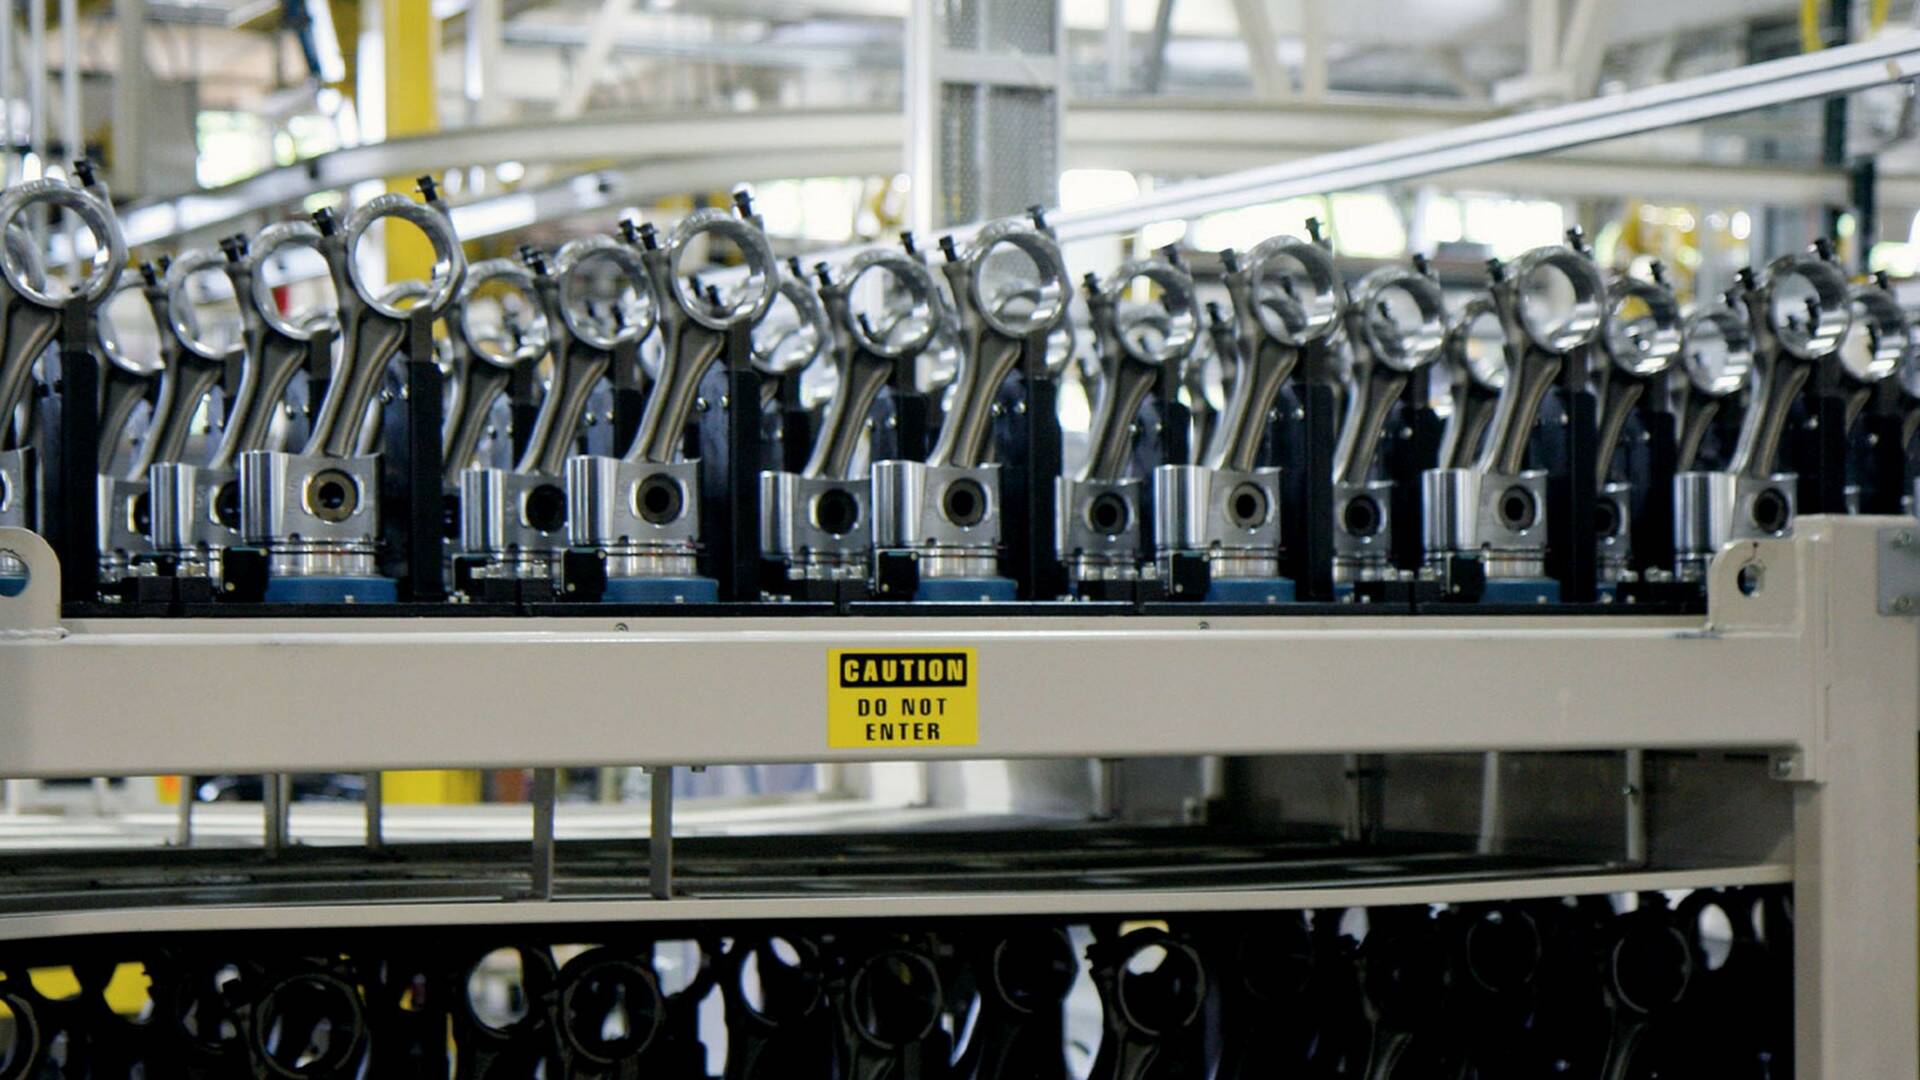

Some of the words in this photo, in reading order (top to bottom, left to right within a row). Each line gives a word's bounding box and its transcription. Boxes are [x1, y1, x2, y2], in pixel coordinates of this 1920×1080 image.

[844, 659, 964, 682] CAUTION
[858, 698, 887, 717] DO
[901, 698, 947, 716] NOT
[866, 722, 940, 741] ENTER
